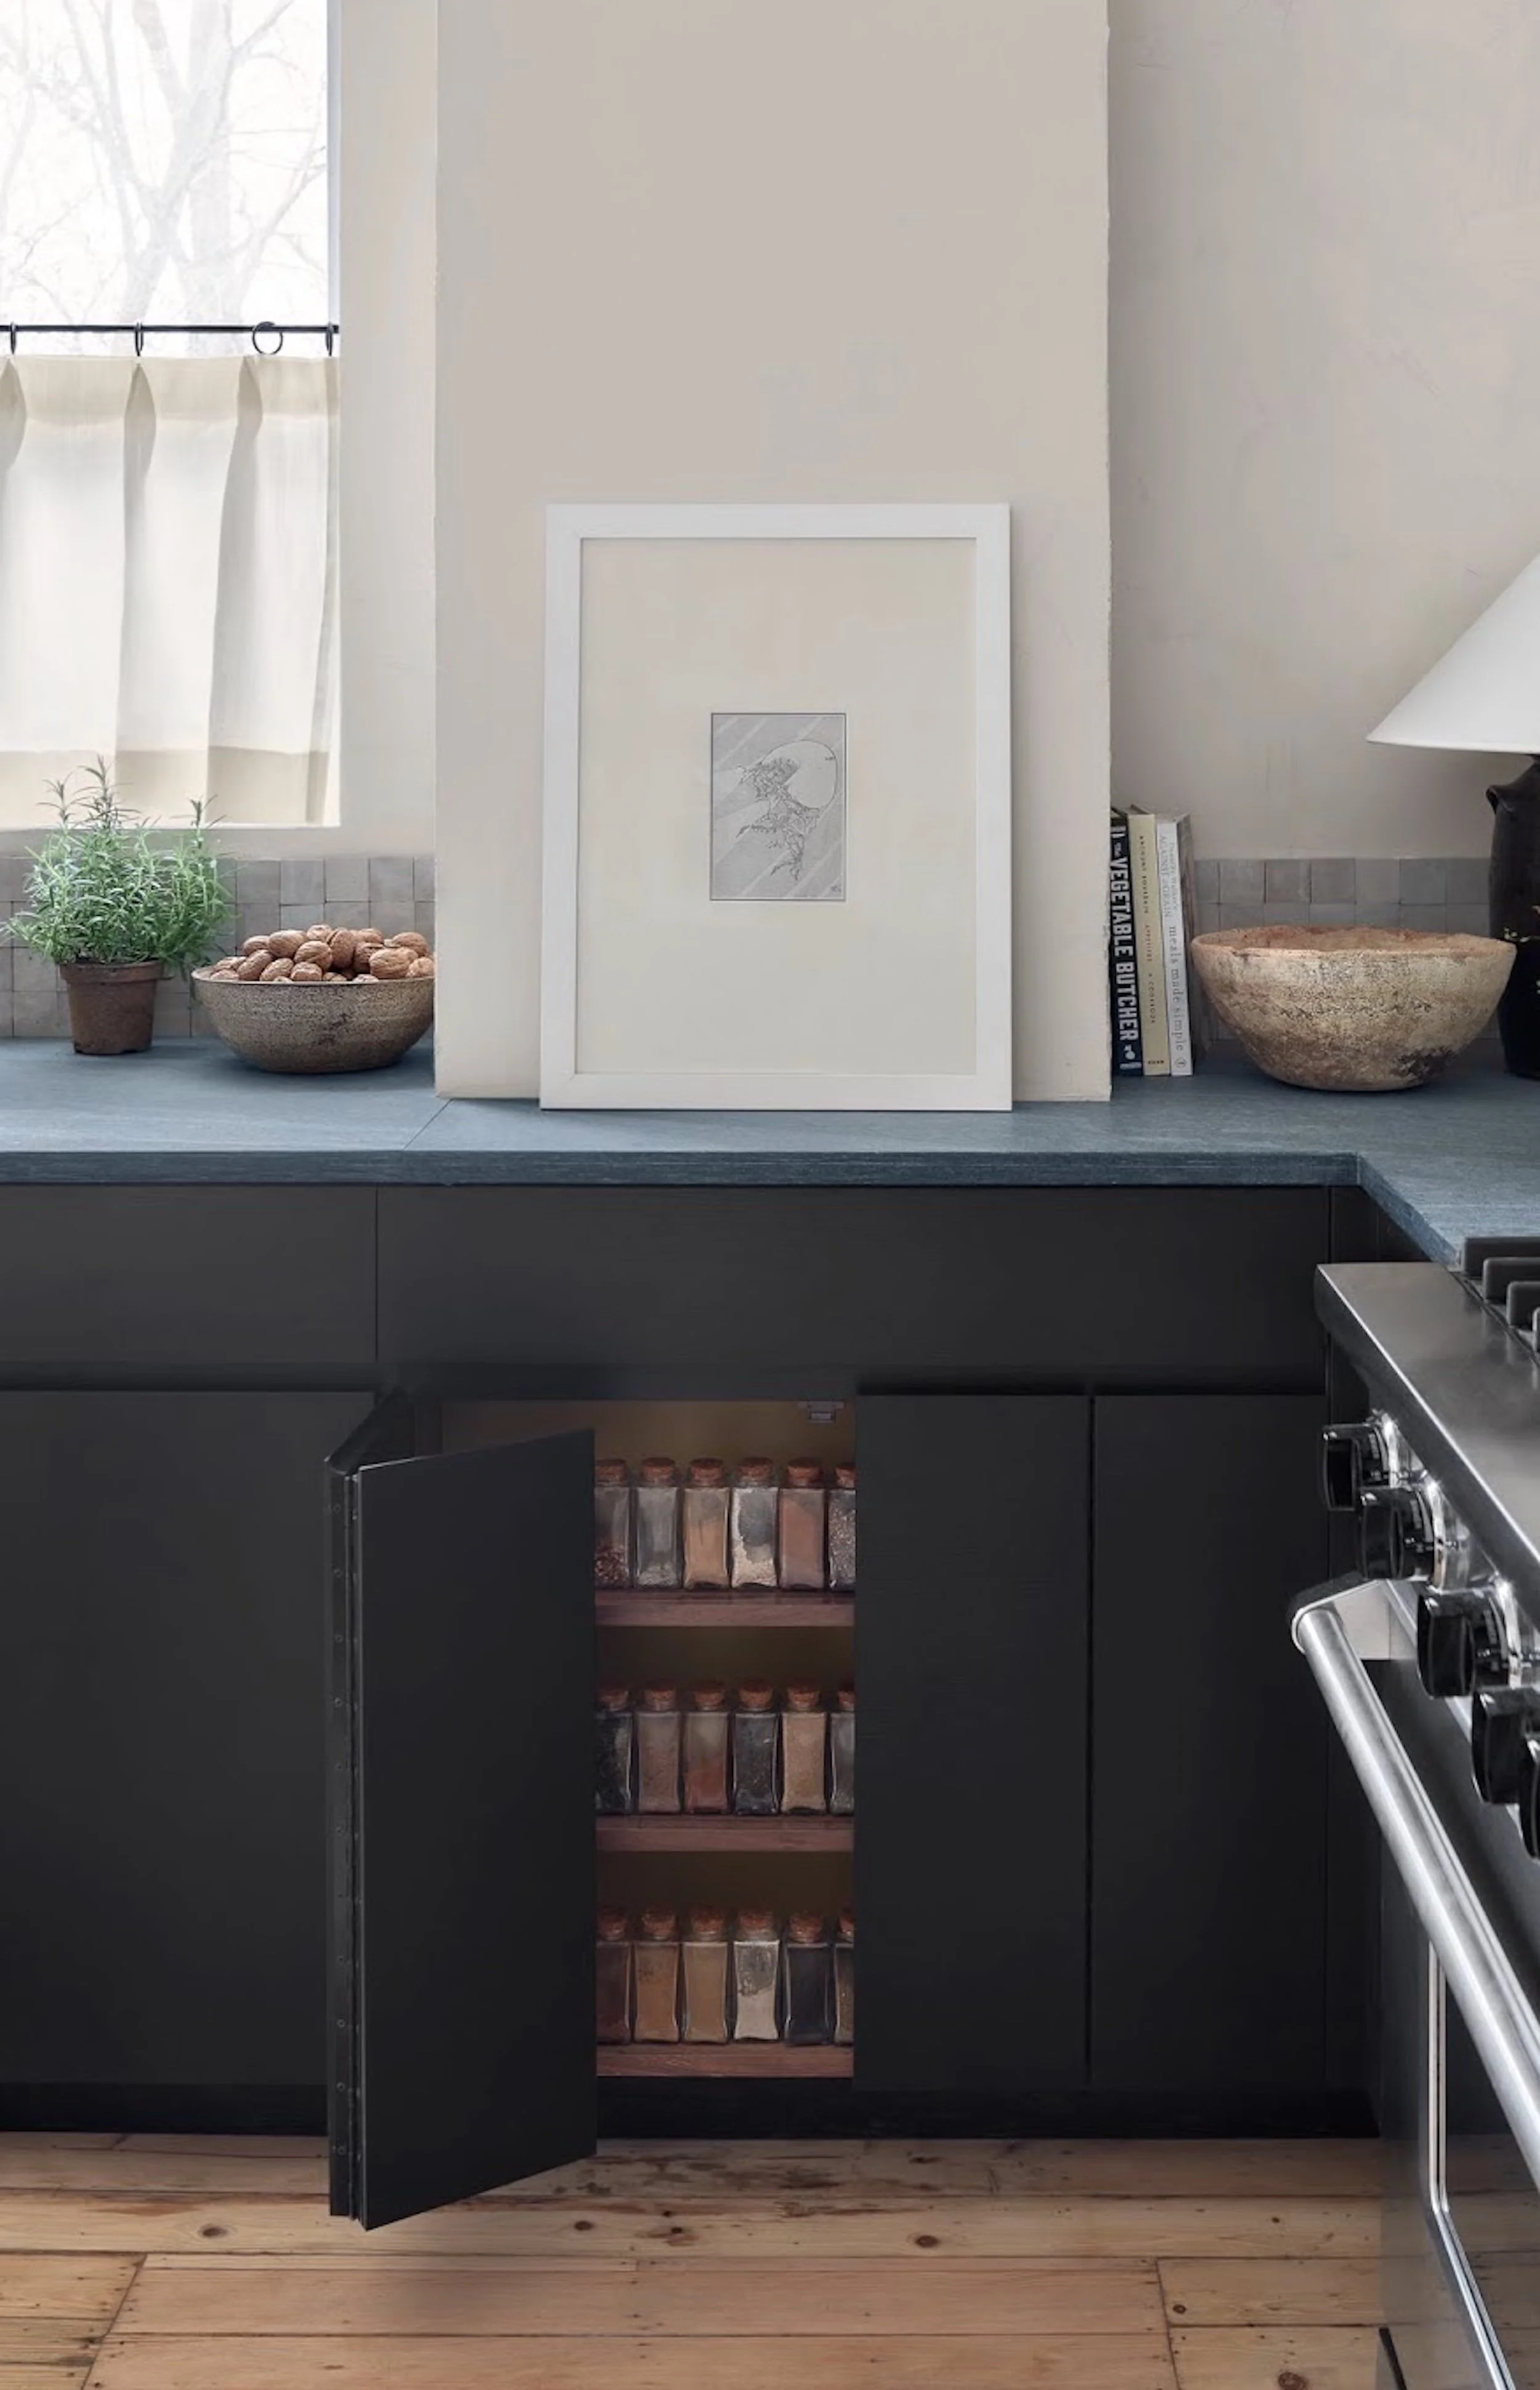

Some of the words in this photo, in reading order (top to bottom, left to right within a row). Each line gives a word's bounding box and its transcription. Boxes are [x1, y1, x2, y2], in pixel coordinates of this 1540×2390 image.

[1111, 856, 1133, 957] VEGETABLE
[1169, 926, 1181, 963] meals
[1116, 962, 1138, 1041] BUTCHER
[1170, 969, 1183, 1003] made
[1172, 1007, 1186, 1050] simple
